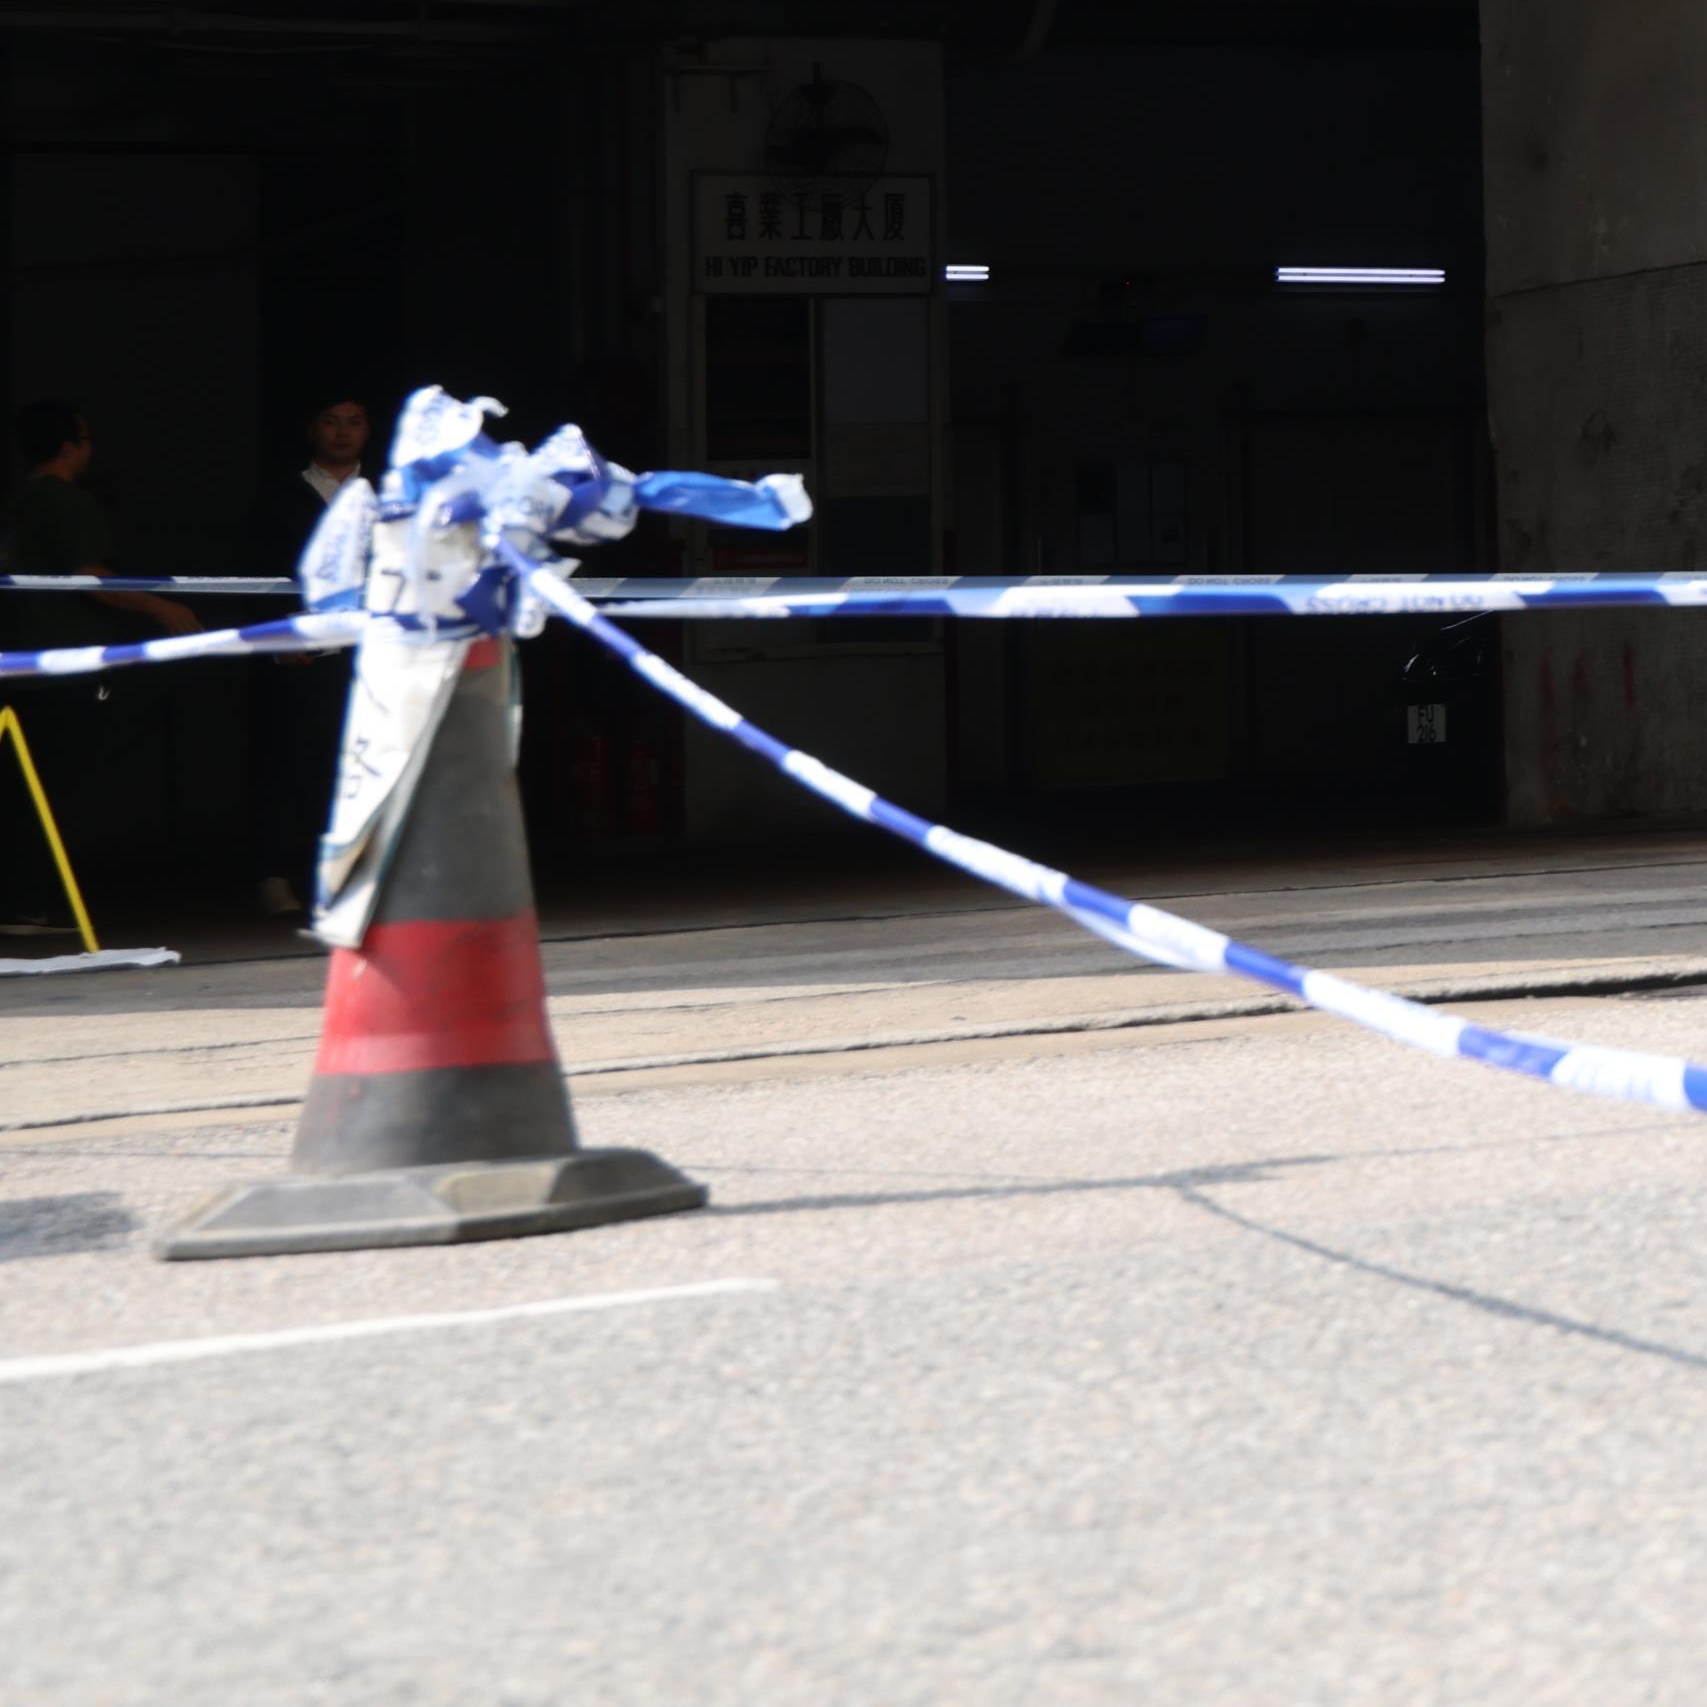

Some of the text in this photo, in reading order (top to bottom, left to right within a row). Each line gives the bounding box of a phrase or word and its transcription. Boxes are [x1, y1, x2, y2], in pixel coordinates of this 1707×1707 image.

[705, 256, 925, 277] HI YIP FACTORY BUILDING
